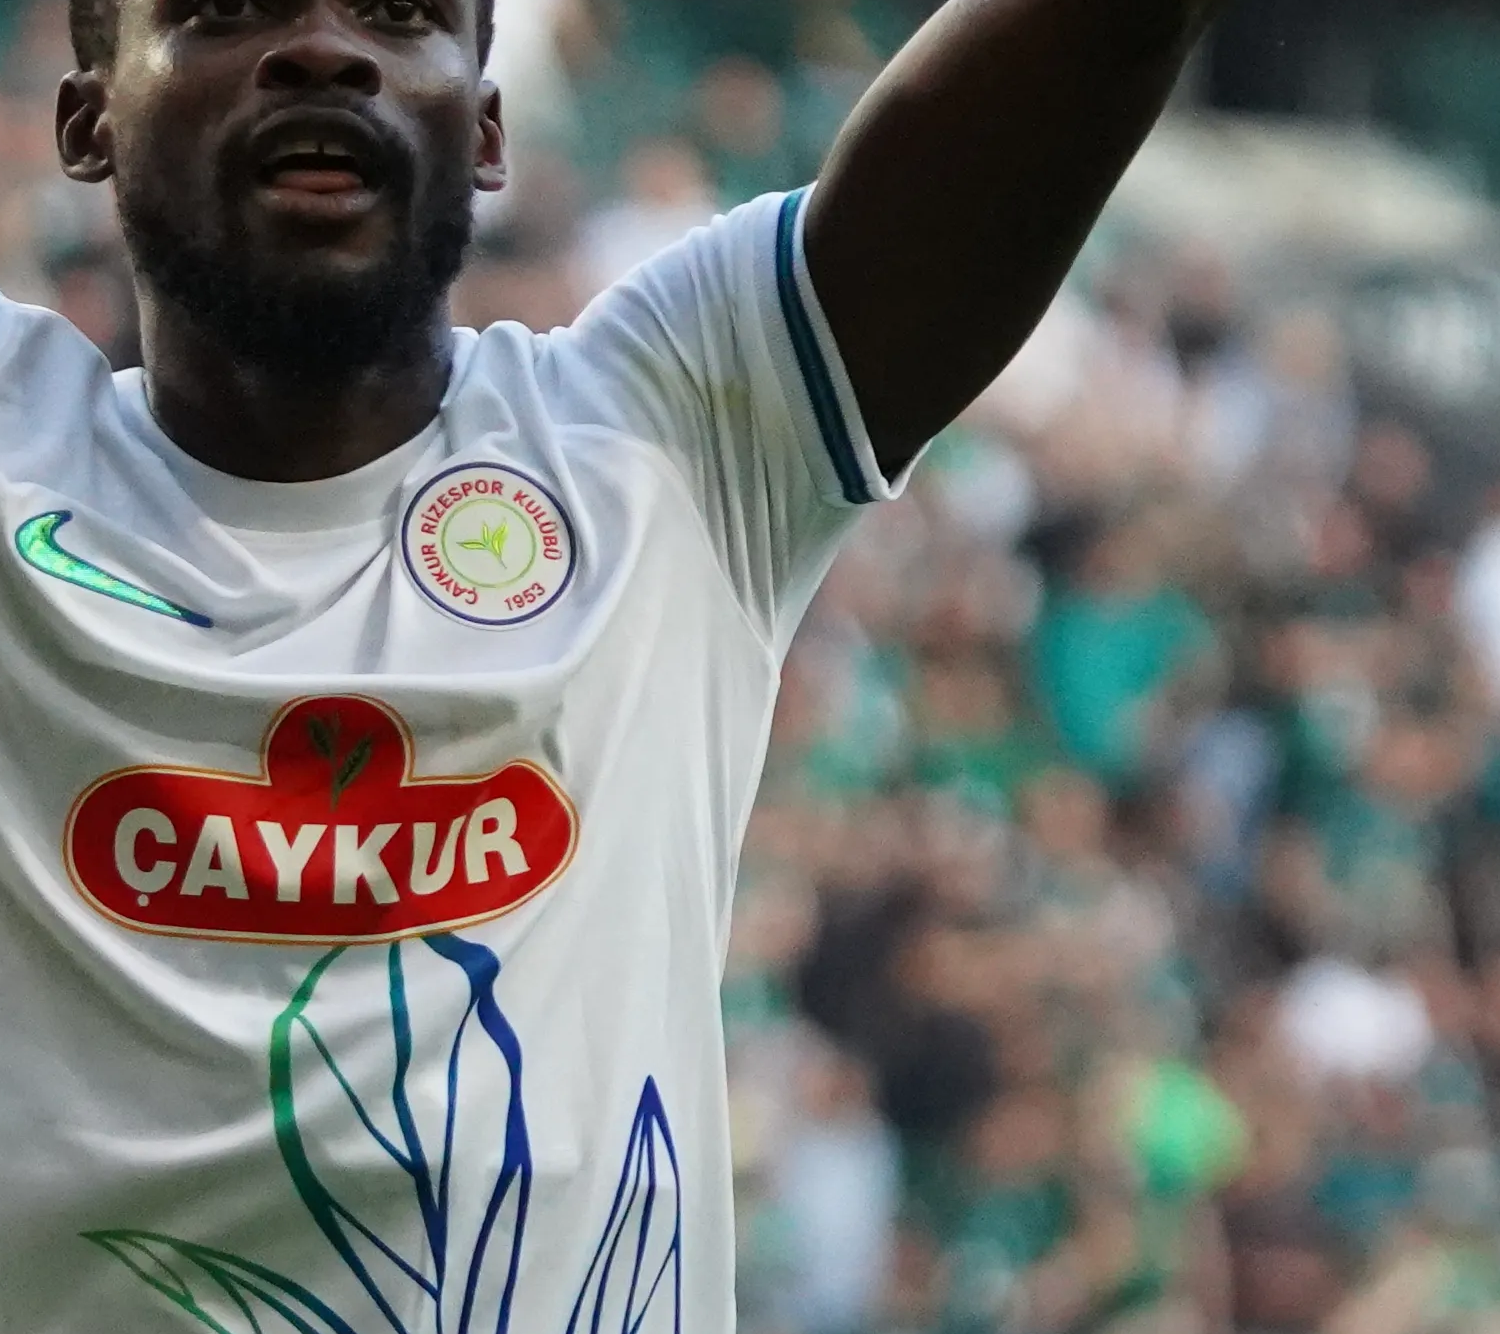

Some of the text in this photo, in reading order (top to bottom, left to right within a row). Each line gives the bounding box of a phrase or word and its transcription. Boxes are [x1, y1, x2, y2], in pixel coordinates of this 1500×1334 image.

[421, 479, 563, 561] RİZESPOR KULÜBÜ
[421, 543, 479, 605] ÇAYKUR
[504, 582, 546, 612] 1953
[114, 796, 531, 907] ÇAYKUR
